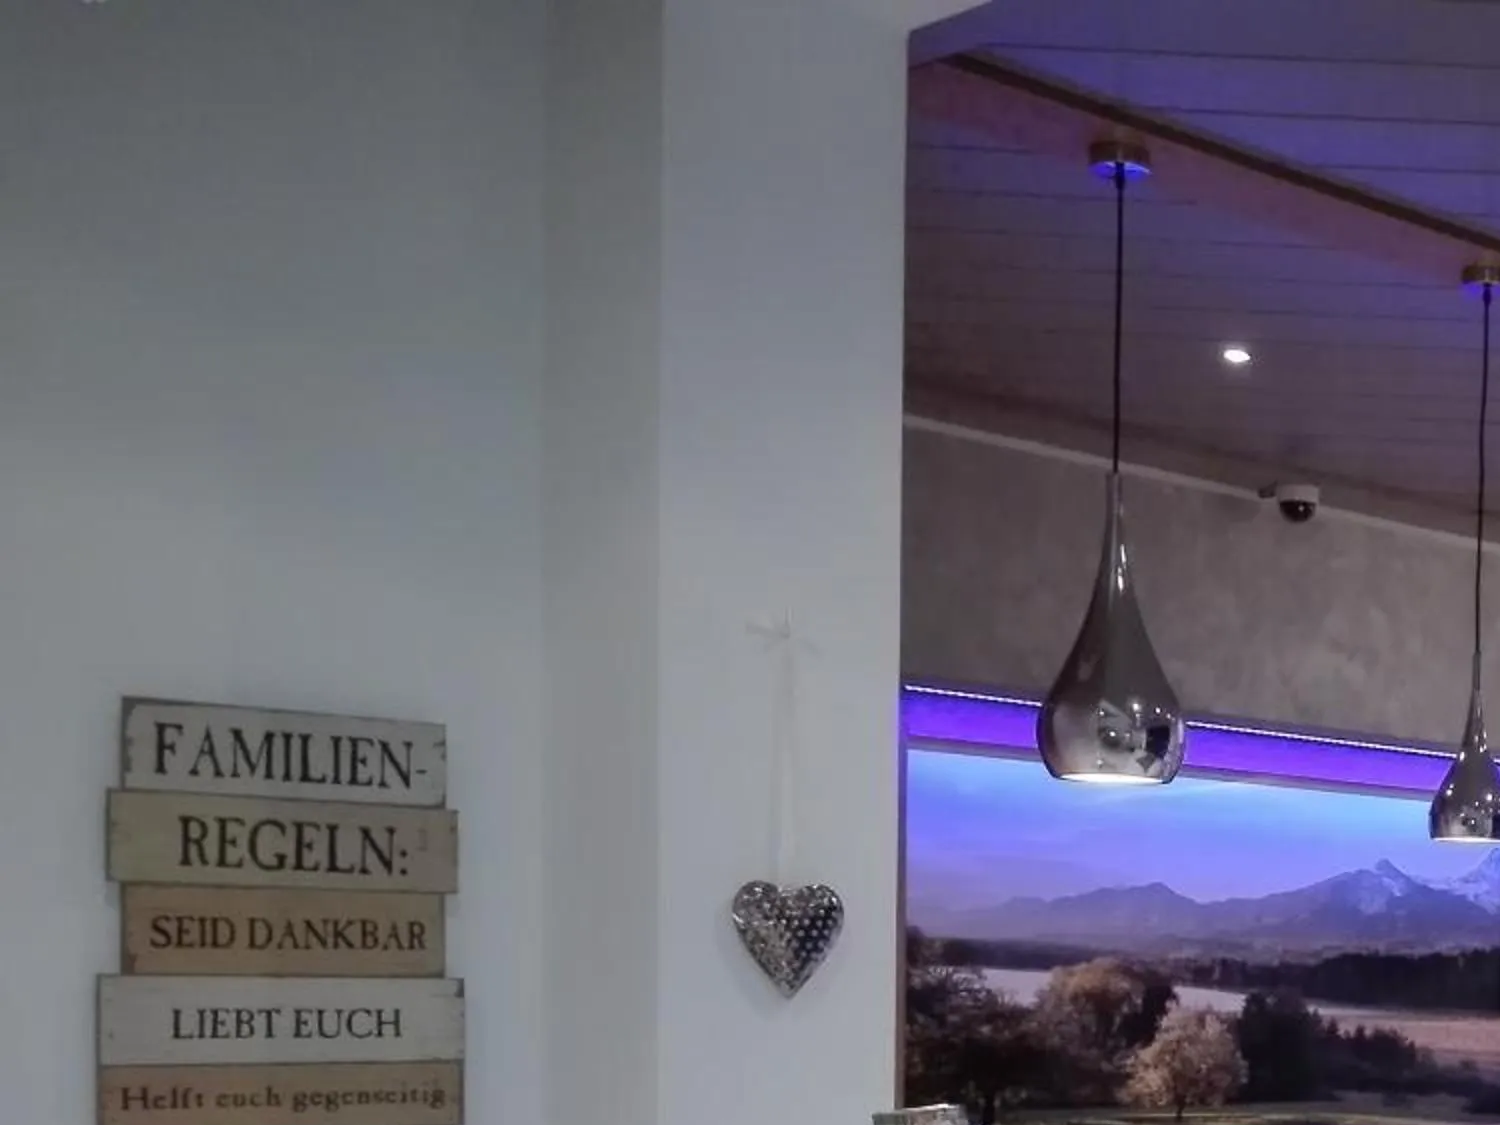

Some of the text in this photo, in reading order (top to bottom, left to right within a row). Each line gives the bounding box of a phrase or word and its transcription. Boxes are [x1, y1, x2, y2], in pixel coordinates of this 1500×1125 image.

[153, 721, 427, 789] FAMILIEN-
[178, 815, 408, 876] REGELN:
[150, 916, 427, 951] SEID DANKBAR
[171, 1007, 402, 1040] LIEBT EUCH
[120, 1080, 447, 1112] Helft euch gegenseitig
